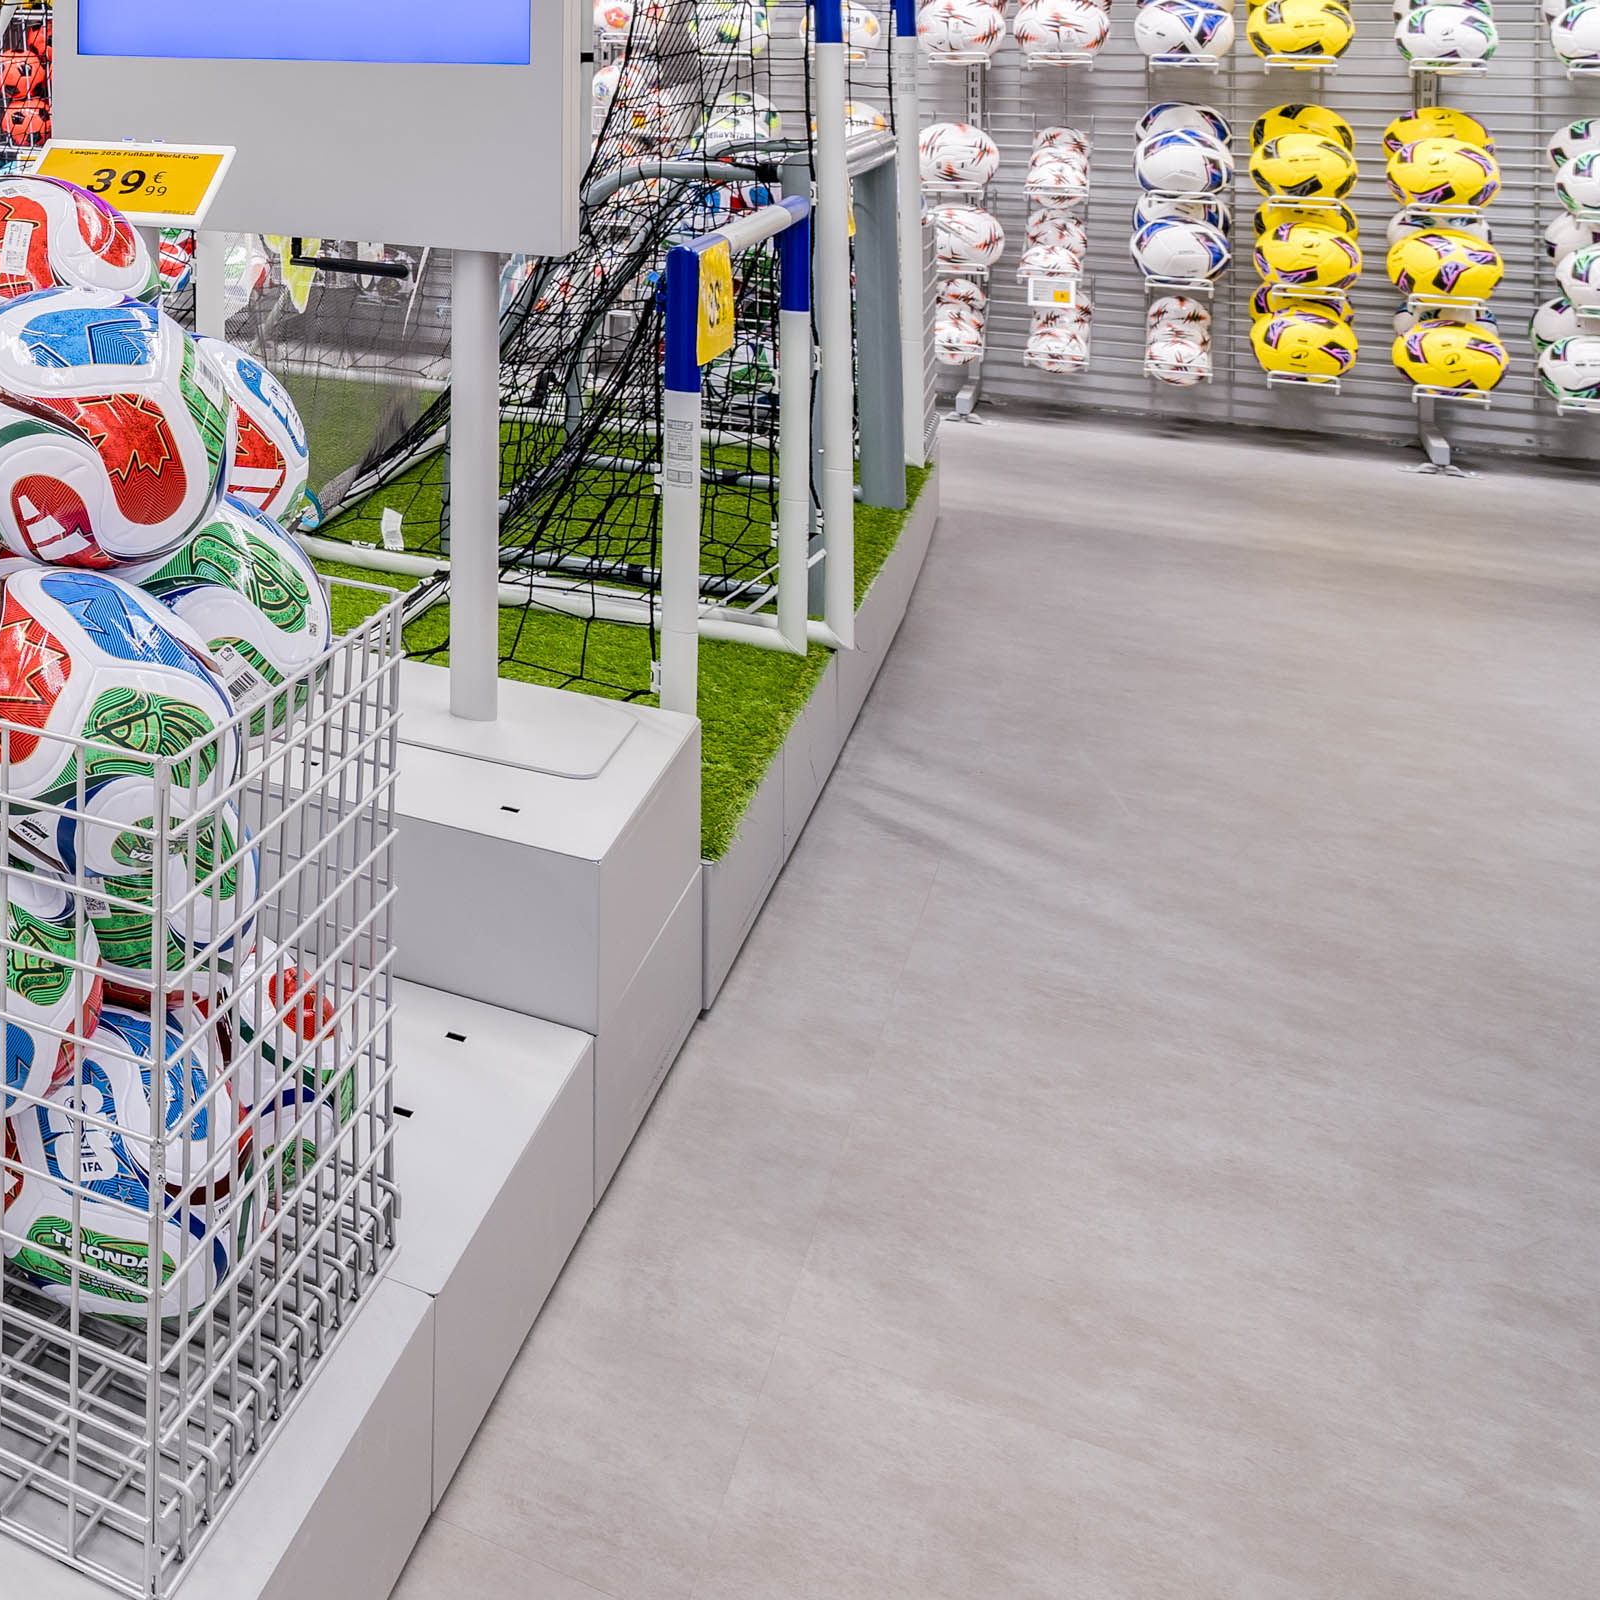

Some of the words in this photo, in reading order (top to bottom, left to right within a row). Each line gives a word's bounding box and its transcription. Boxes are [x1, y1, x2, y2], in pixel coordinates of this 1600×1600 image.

[87, 169, 146, 194] 39
[145, 186, 167, 196] 99
[76, 1162, 103, 1173] IFA
